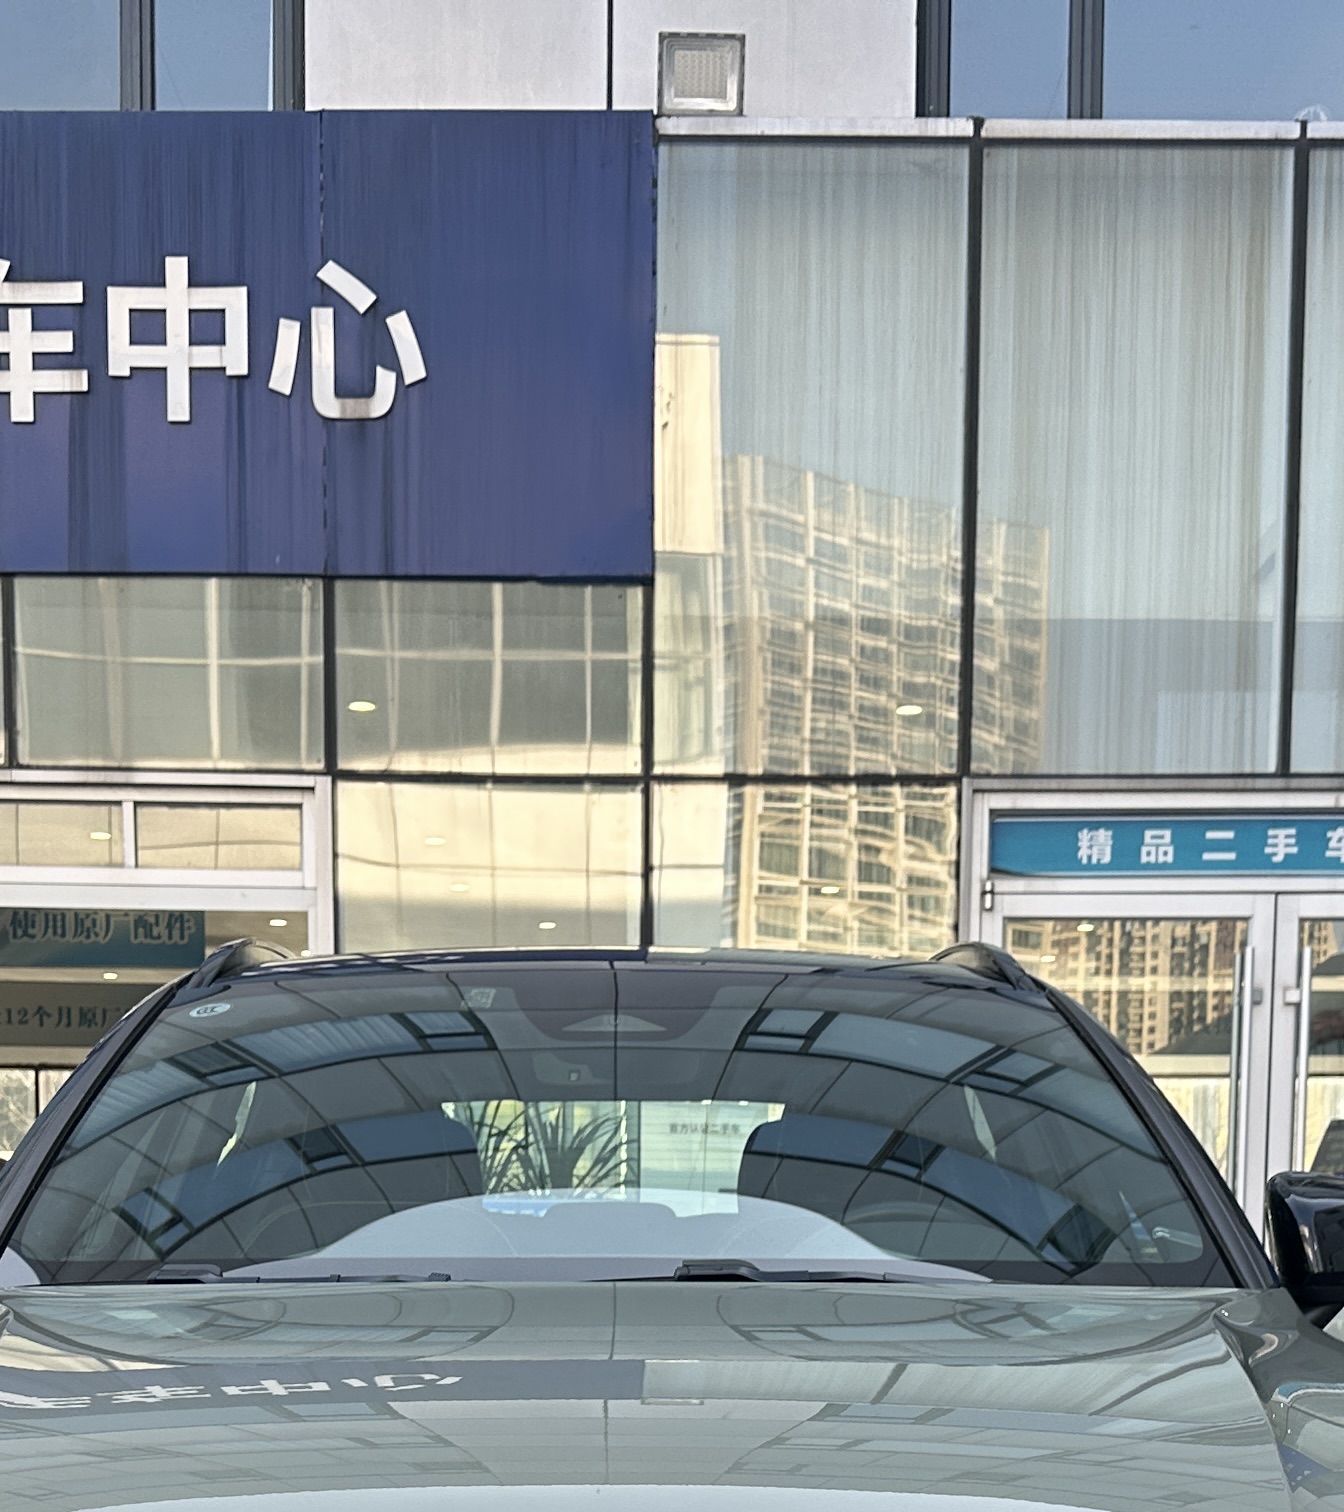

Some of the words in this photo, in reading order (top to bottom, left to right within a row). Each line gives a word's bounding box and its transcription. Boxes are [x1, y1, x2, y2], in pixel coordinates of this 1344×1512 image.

[9, 909, 196, 944] 使用原厂配件
